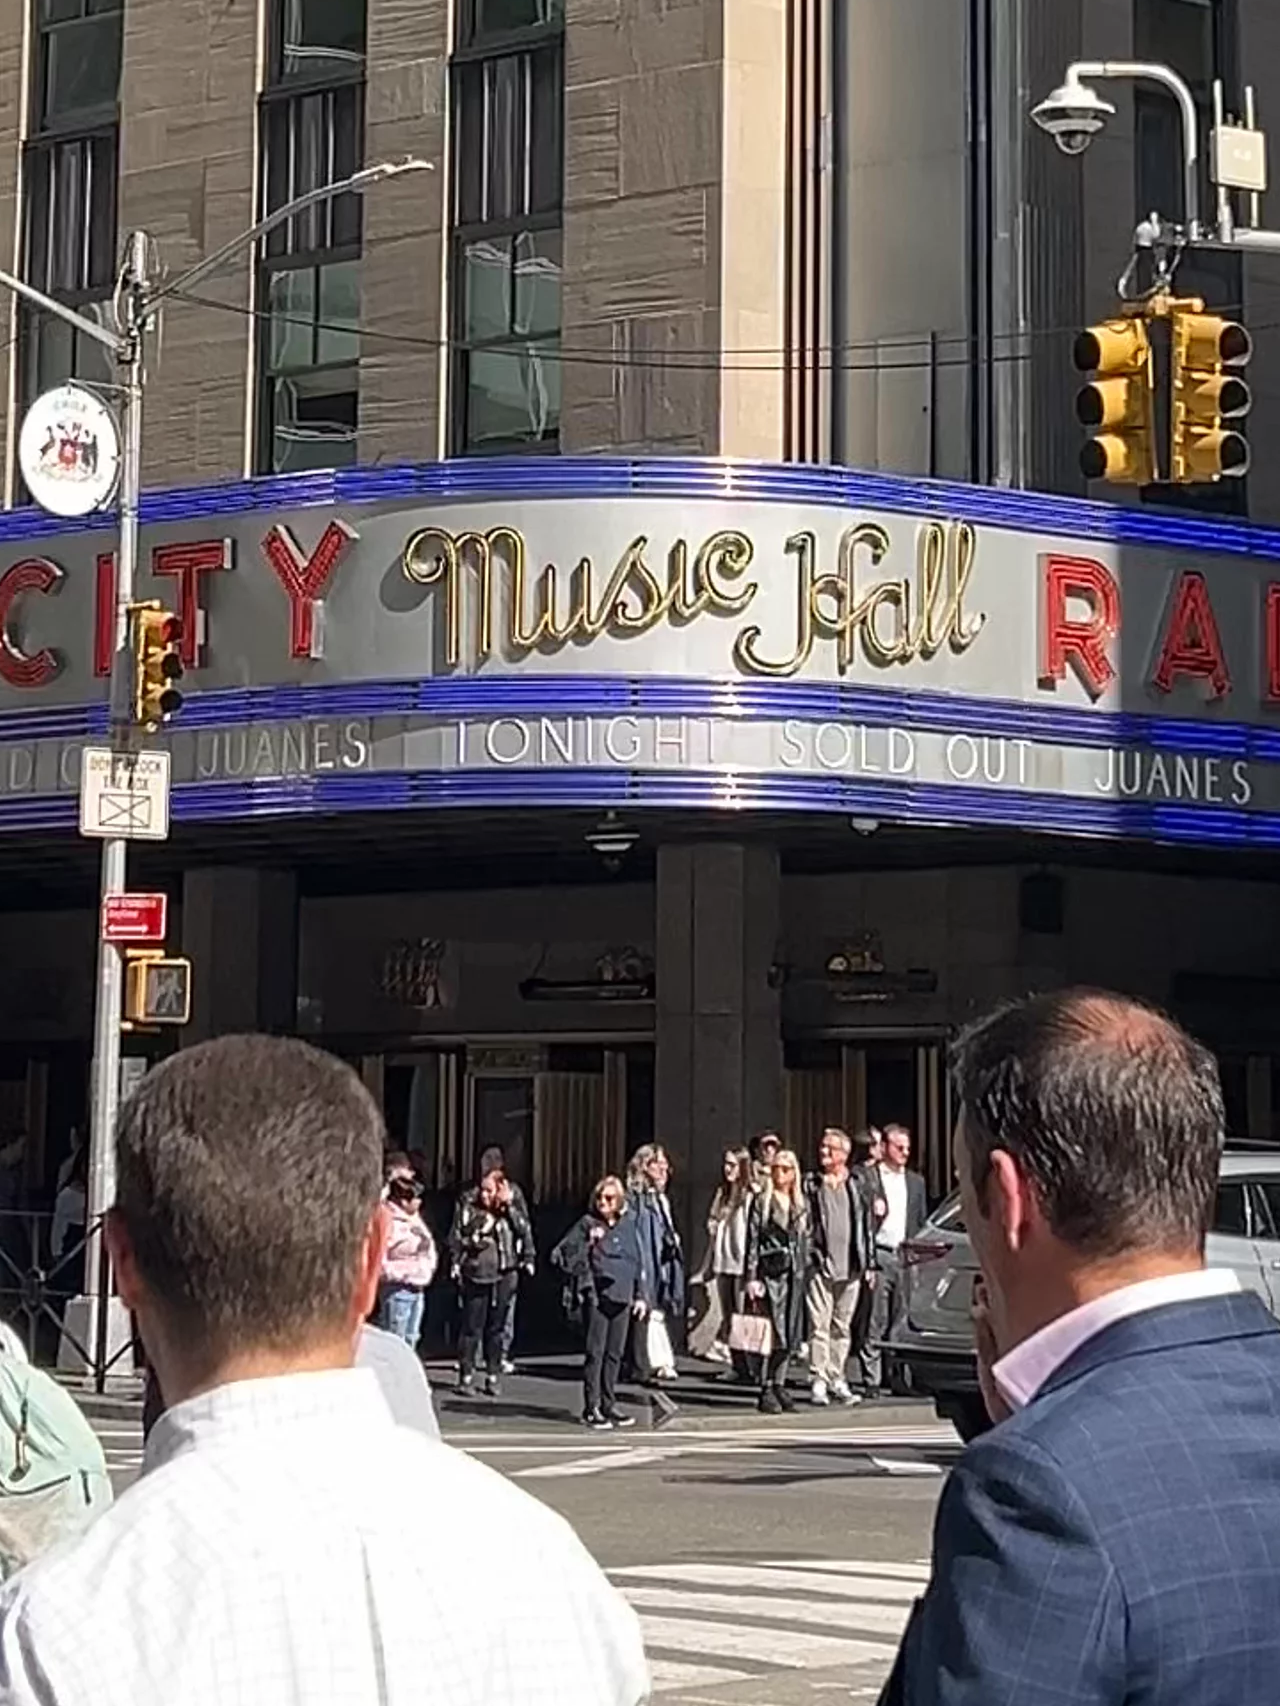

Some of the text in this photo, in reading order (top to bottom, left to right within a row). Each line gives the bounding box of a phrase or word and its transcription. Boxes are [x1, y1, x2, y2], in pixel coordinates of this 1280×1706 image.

[403, 520, 987, 678] Music Hall
[199, 719, 369, 779] JUANES
[455, 716, 721, 766] TONIGHT
[779, 718, 915, 774] SOLD
[946, 733, 1033, 786] OUT
[1092, 749, 1253, 806] JUANES
